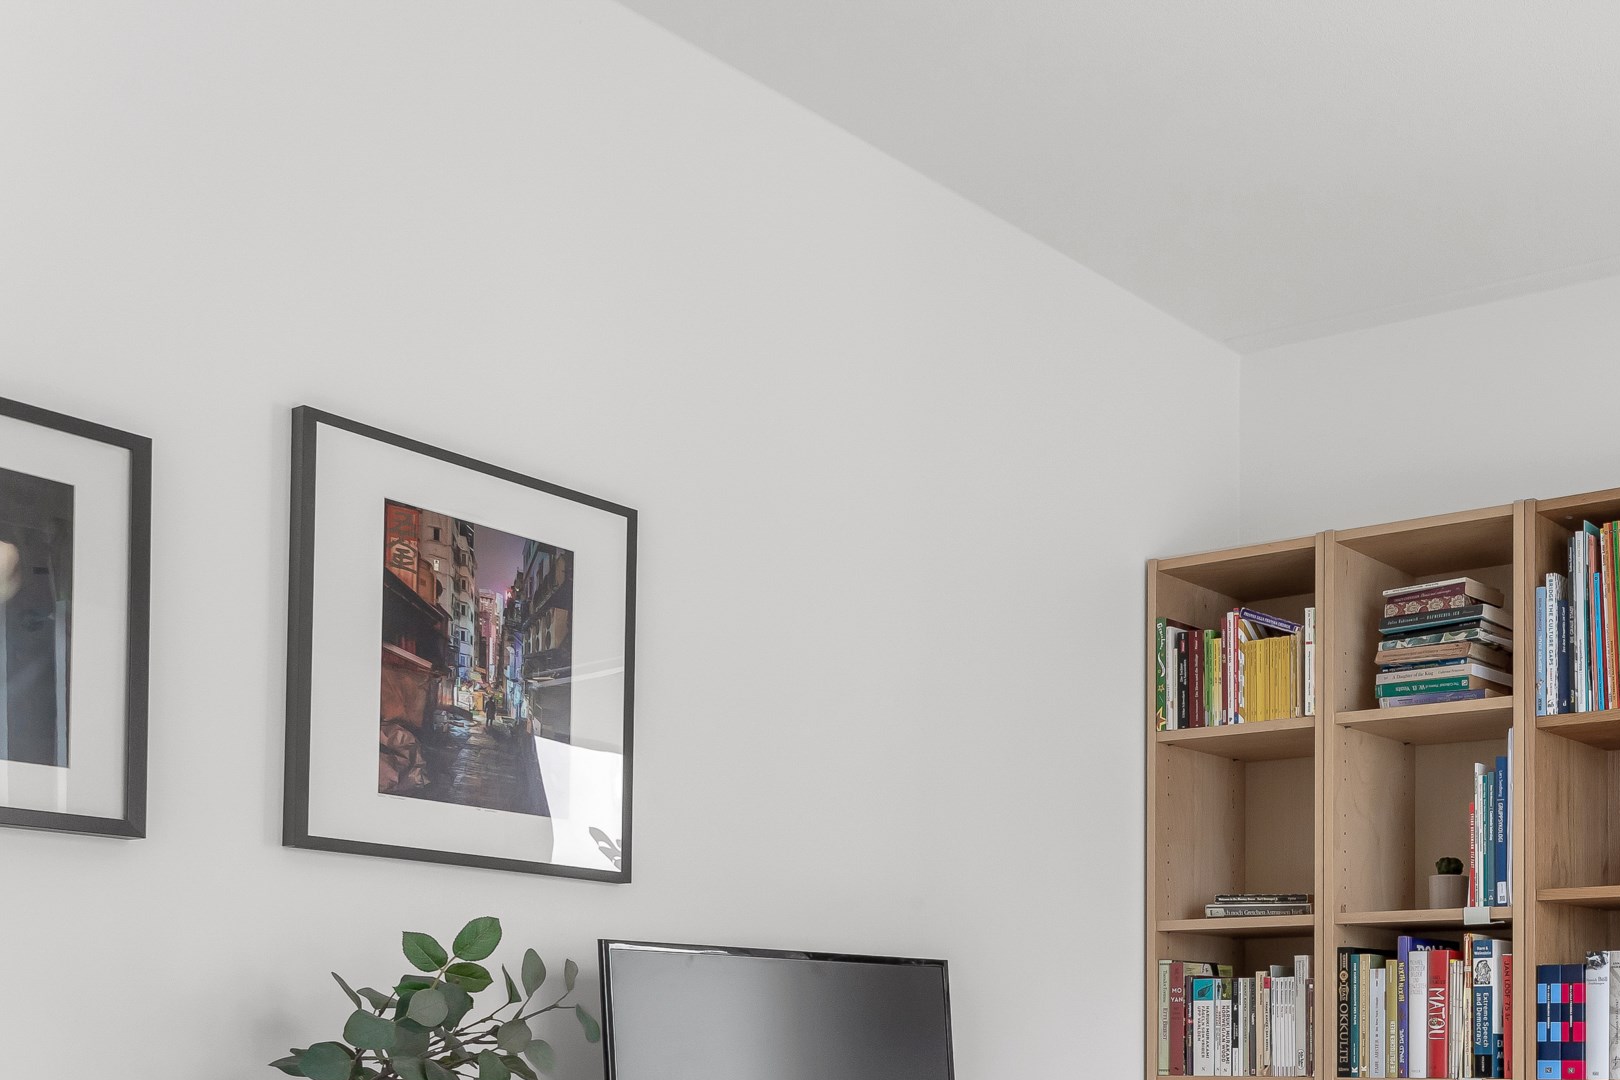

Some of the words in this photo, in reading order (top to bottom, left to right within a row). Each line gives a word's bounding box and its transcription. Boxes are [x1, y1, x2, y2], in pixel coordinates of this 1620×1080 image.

[1339, 1003, 1348, 1063] OKKULTE
[1428, 986, 1446, 1041] MATOU
[1481, 1021, 1489, 1048] Speech
